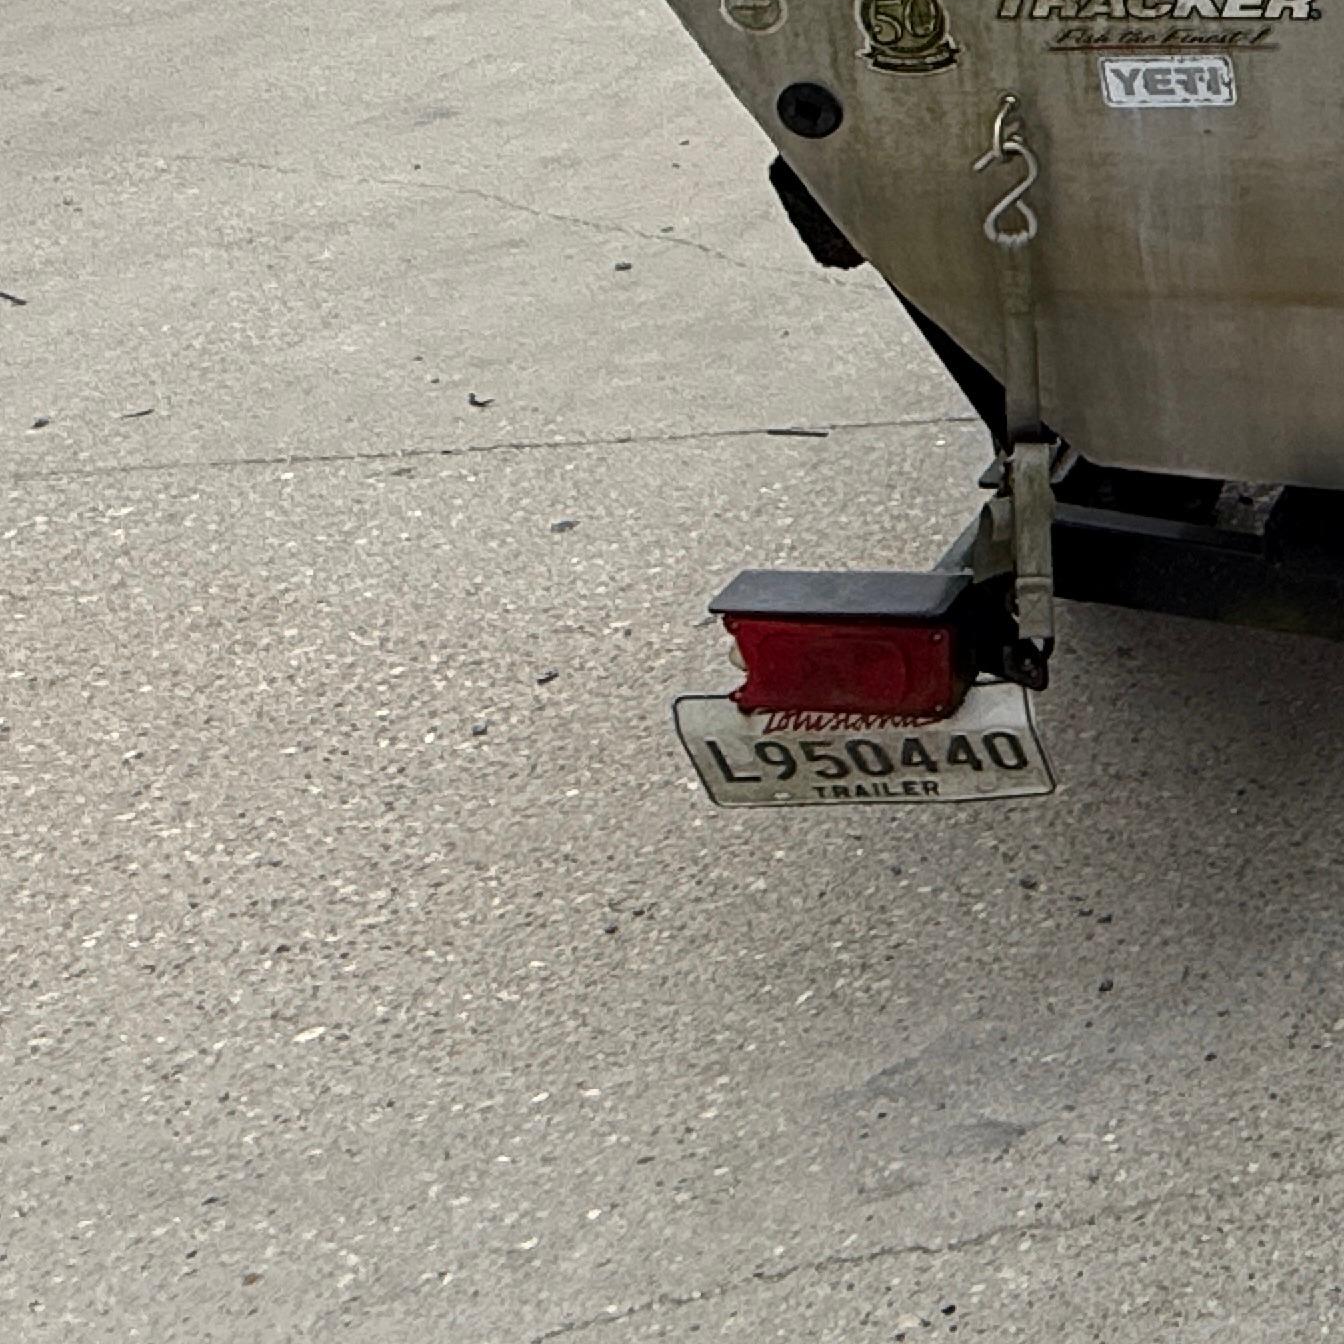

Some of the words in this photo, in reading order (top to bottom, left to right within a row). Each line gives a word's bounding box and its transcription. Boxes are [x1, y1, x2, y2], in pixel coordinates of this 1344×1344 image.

[1110, 66, 1223, 96] YETI
[704, 731, 1030, 783] L950440
[812, 781, 941, 799] TRAILER
